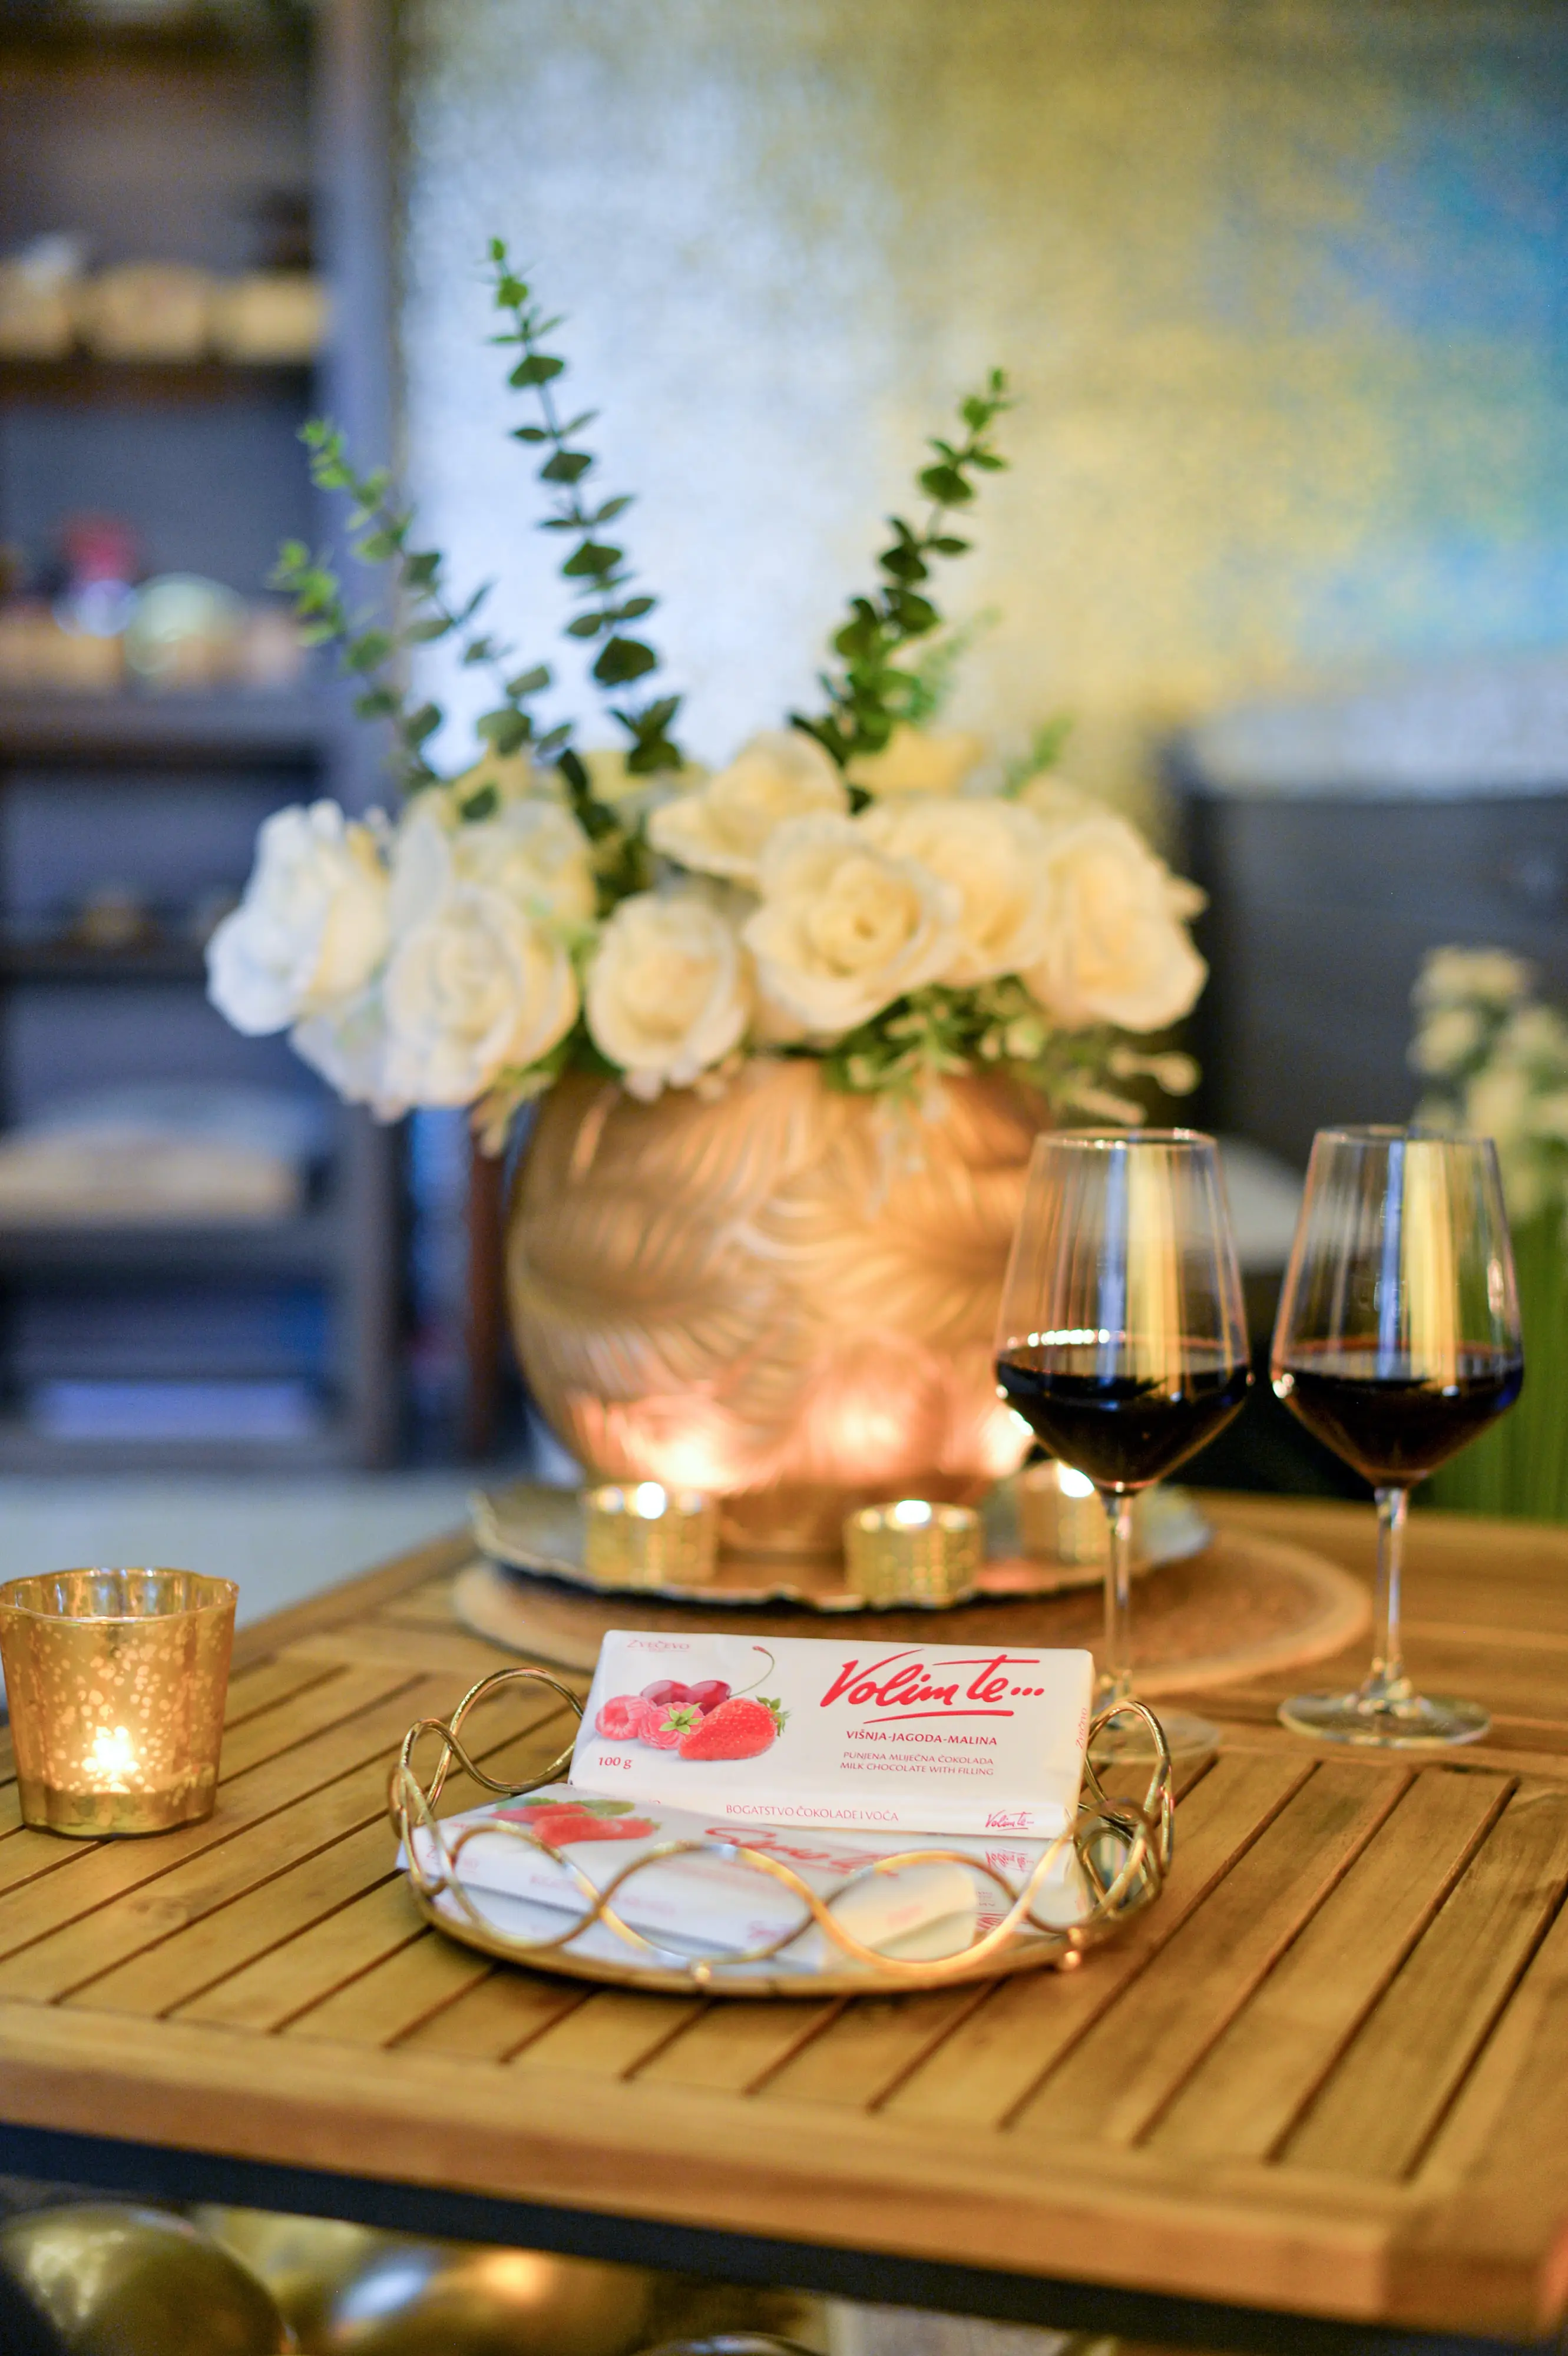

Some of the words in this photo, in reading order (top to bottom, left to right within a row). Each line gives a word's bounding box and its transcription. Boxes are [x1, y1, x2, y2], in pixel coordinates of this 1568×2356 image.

[819, 1649, 960, 1708] Volim
[846, 1729, 997, 1746] VIŠNJA-JAGODA-MALINA
[598, 1756, 621, 1766] 100
[623, 1758, 633, 1769] g
[843, 1752, 886, 1760] PUNJENA
[889, 1753, 935, 1762] MLIJEČNA
[938, 1754, 994, 1765] ČOKOLADA
[840, 1762, 864, 1770] MILK
[866, 1763, 927, 1772] CHOCOLATE
[958, 1767, 994, 1775] FILLING
[726, 1804, 794, 1816] BOGATSTVO
[796, 1805, 858, 1820] ČOKOLADE
[985, 1809, 1015, 1828] Volim
